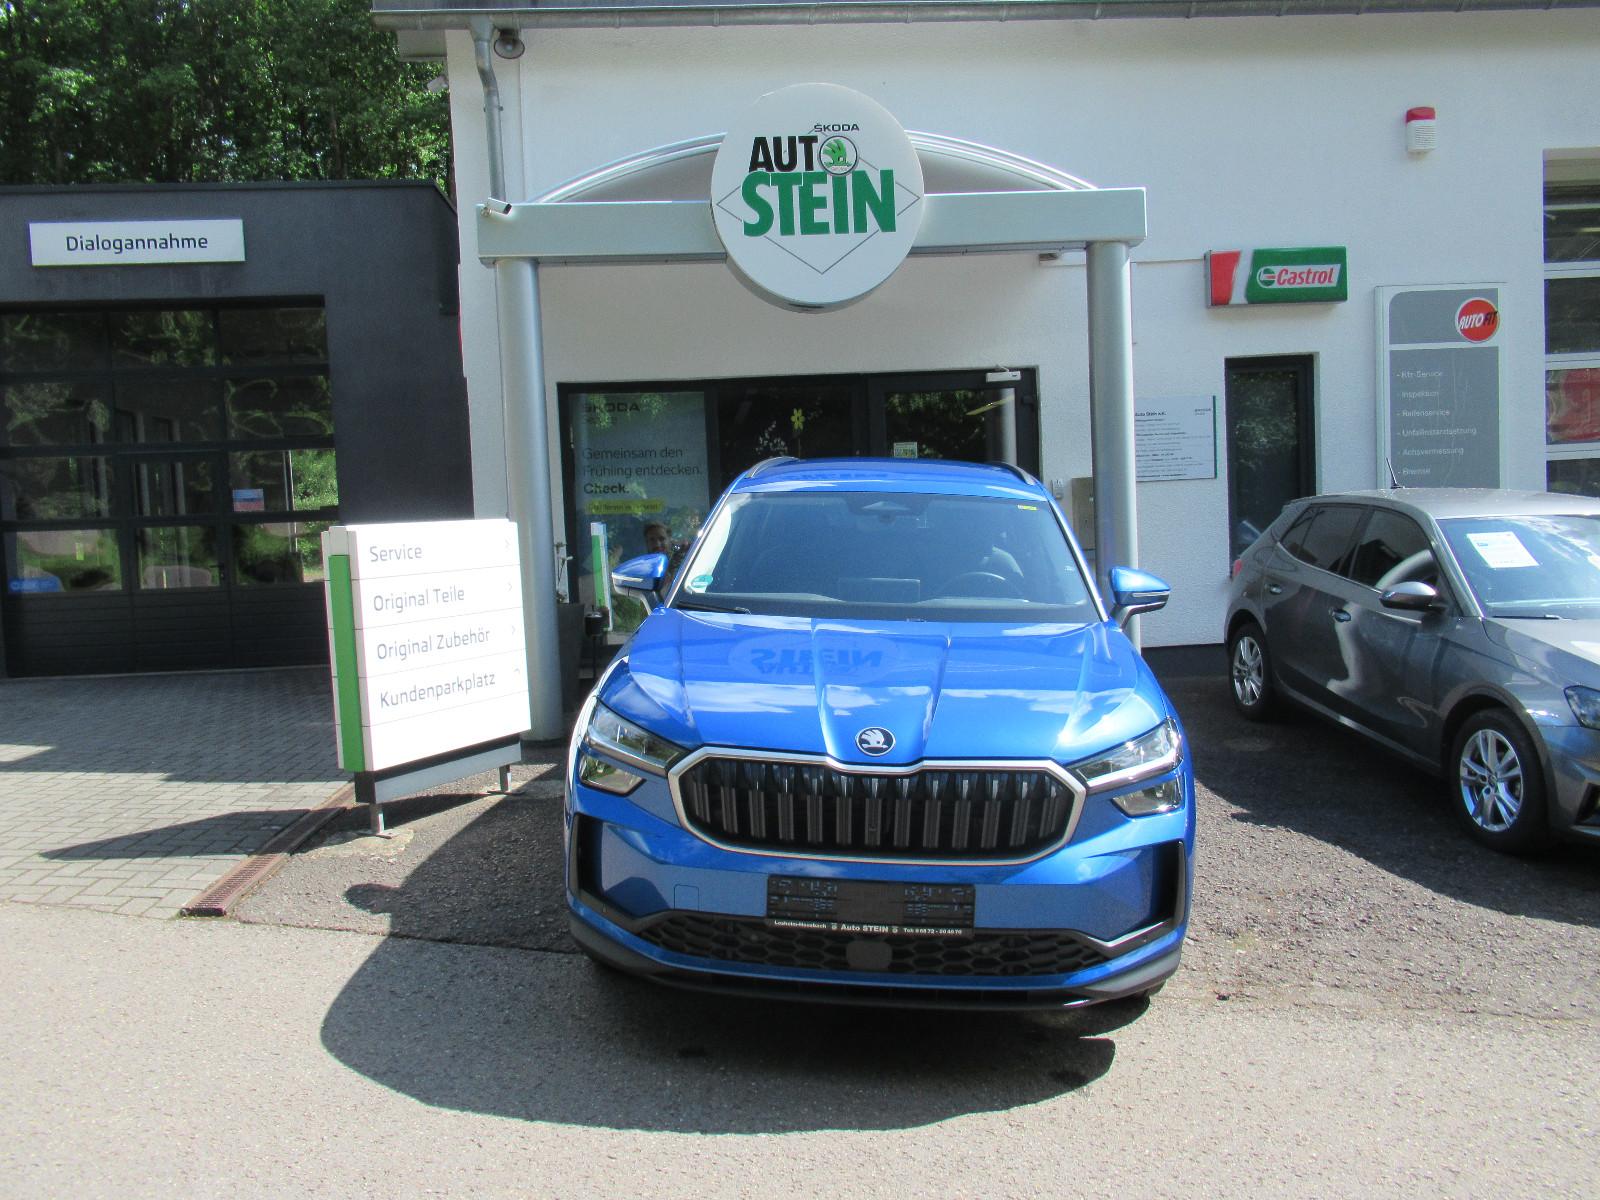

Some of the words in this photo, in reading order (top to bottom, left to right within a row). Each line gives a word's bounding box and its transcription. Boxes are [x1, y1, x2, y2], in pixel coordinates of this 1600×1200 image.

[813, 122, 860, 132] ŠKODA
[741, 169, 897, 237] STEIN
[66, 233, 208, 255] Dialogannahme
[1276, 267, 1334, 286] Castrol
[582, 447, 657, 460] Gemeinsam
[660, 446, 683, 458] den
[369, 544, 423, 562] Service
[373, 588, 429, 613] Original
[433, 585, 465, 604] Teile
[377, 635, 433, 661] Original
[436, 627, 491, 650] Zubehör
[380, 673, 496, 708] Kundenparkplatz
[840, 923, 860, 932] Auto
[862, 924, 889, 933] STEIN
